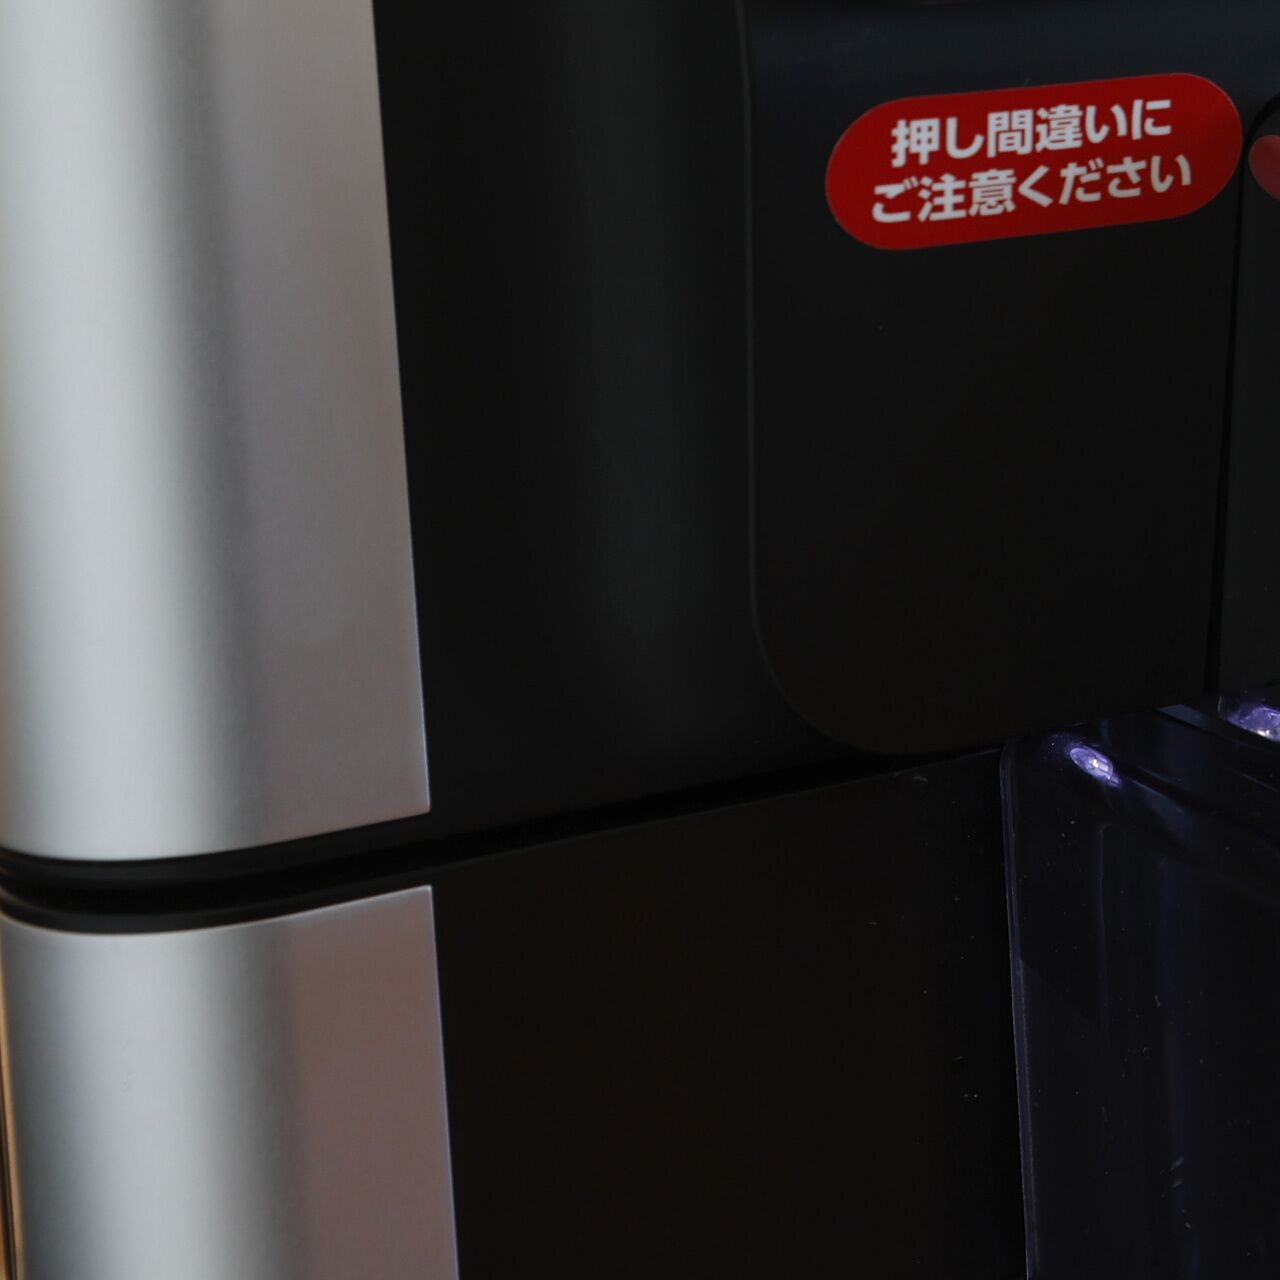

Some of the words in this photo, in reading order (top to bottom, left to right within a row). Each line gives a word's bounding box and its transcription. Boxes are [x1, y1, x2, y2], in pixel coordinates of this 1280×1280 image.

[890, 99, 1172, 168] 押し間違いに
[871, 154, 1192, 223] ご注意ください
